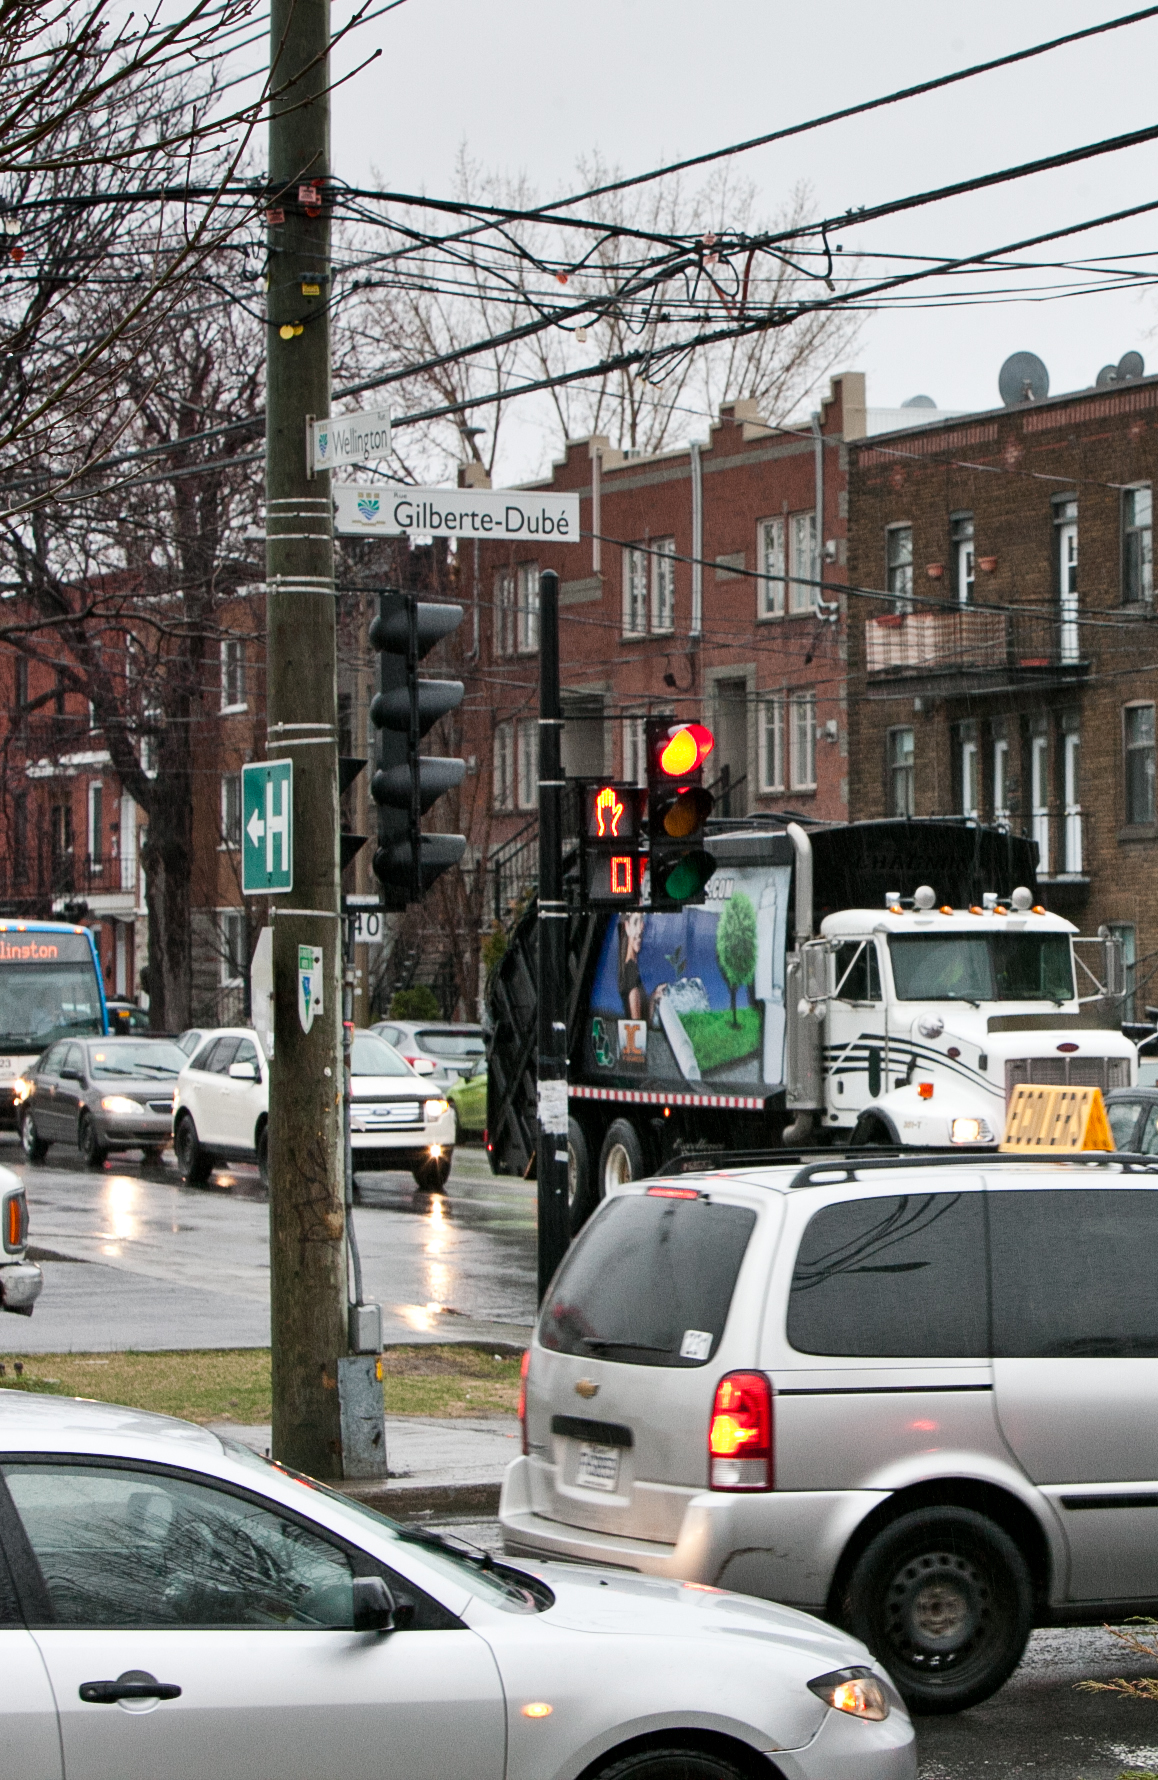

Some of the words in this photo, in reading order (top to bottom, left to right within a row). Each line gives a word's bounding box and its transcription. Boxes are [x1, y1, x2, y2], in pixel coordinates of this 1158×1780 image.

[332, 428, 388, 460] Wellington
[394, 501, 569, 535] Gilberte-Dubé
[266, 779, 289, 873] H
